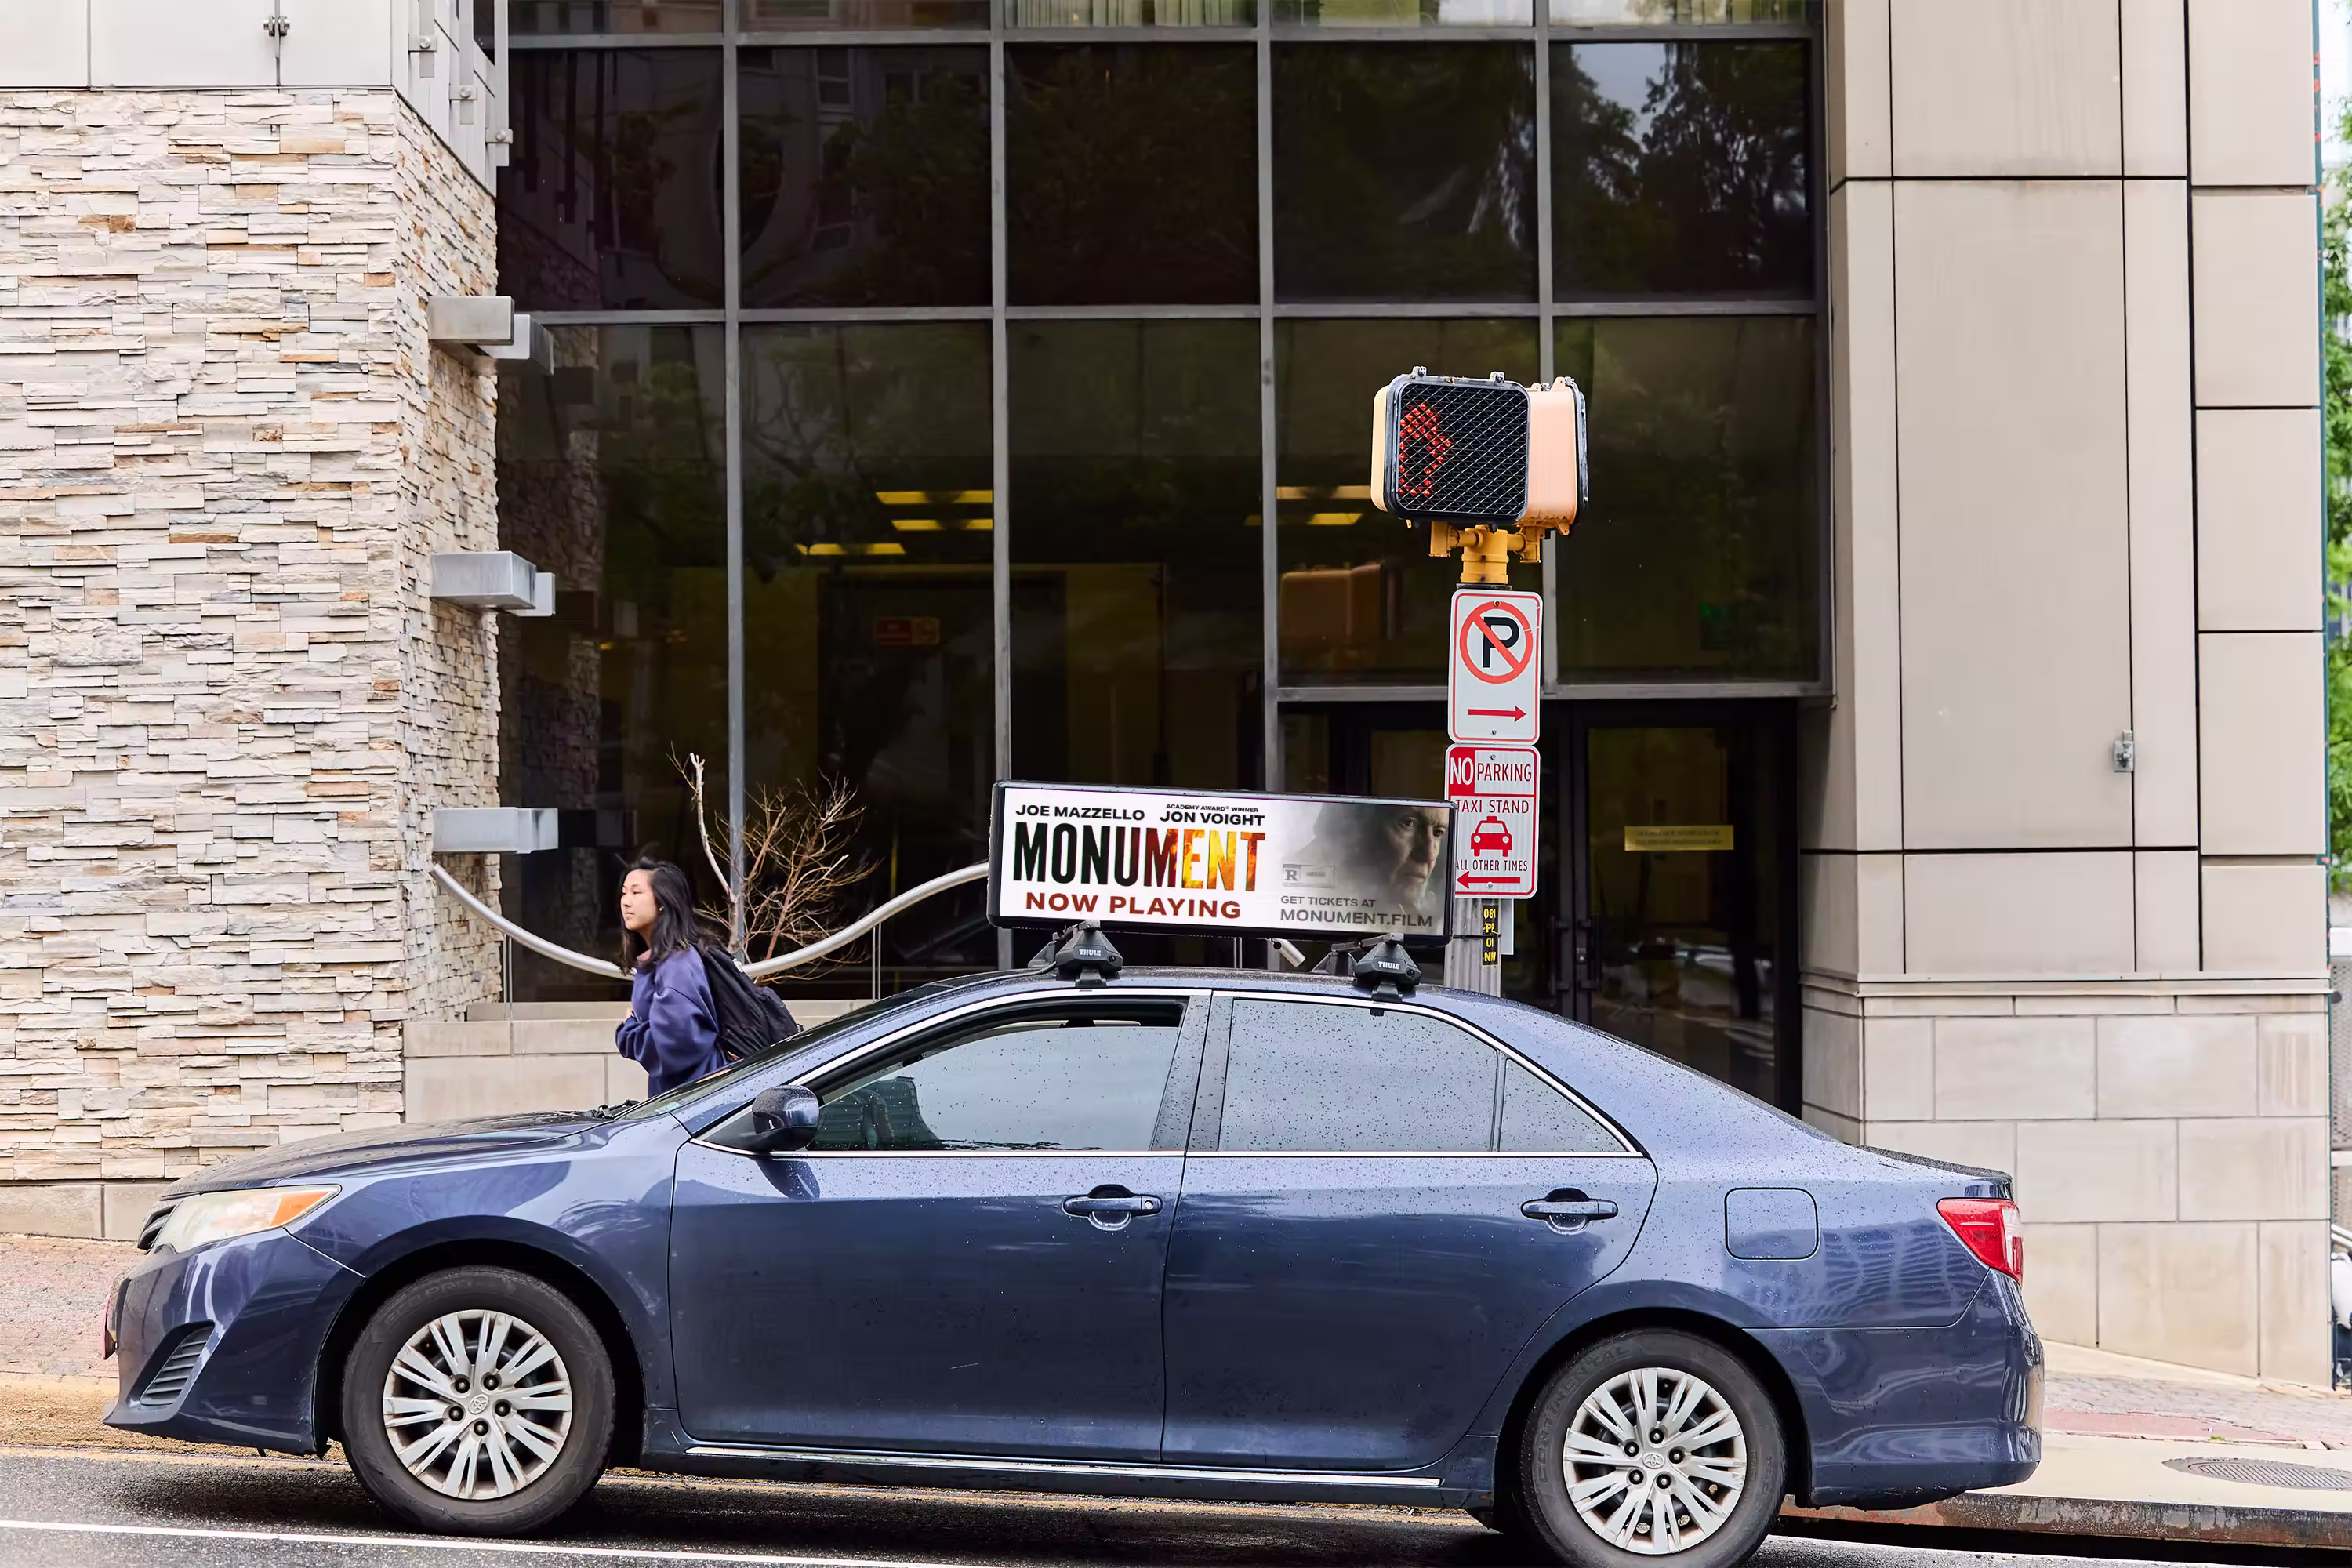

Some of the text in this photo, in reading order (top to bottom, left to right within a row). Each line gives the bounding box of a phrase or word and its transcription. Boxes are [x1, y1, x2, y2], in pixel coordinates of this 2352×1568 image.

[1450, 757, 1532, 786] NO PARKING
[1015, 804, 1145, 821] JOE MAZZELLO
[1456, 799, 1530, 814] TAXI STAND
[1160, 811, 1265, 826] JON VOIGHT
[1013, 821, 1266, 892] MONUMENT
[1456, 859, 1528, 872] ALL OTHER TIMES
[1284, 869, 1299, 882] R
[1025, 892, 1241, 919] NOW PLAYING
[1280, 895, 1377, 908] GET TICKETS AT
[1280, 909, 1433, 927] MONUMENT.FILM
[1484, 951, 1497, 962] NW
[1377, 961, 1400, 970] THULE
